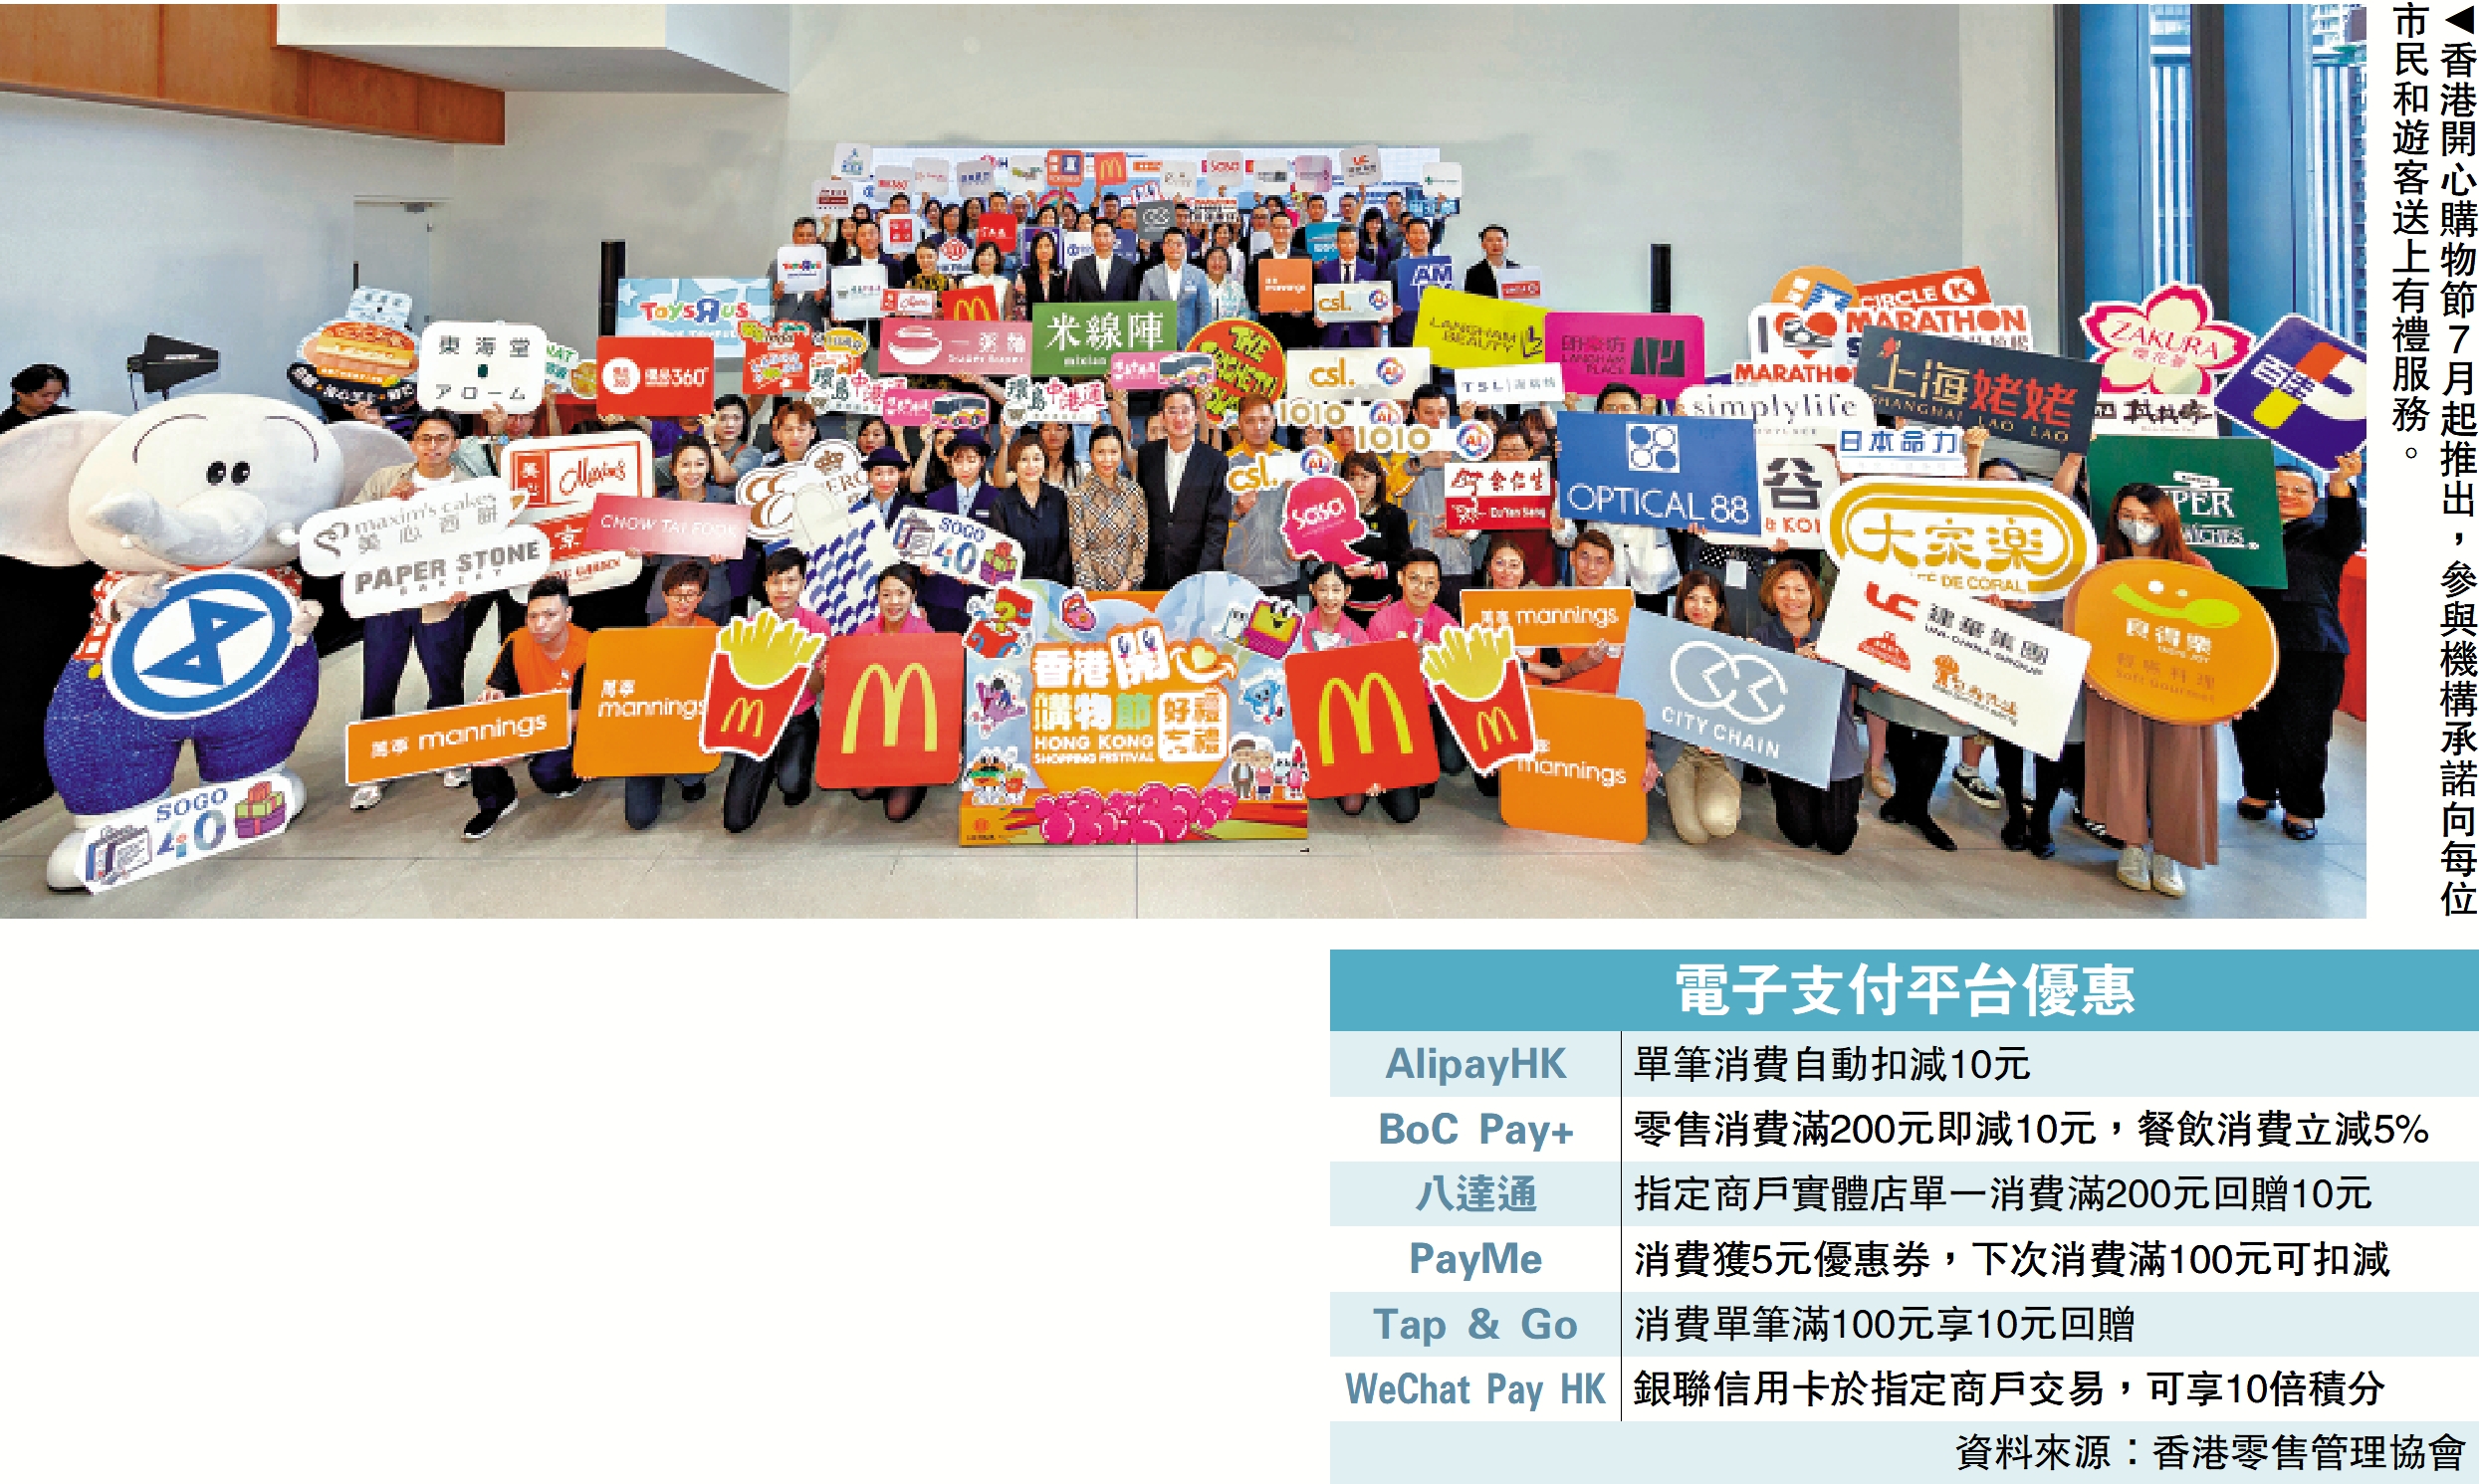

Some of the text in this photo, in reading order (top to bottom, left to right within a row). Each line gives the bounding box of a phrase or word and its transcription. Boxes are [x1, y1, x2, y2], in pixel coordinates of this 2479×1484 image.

[1046, 312, 1164, 350] 米線陣
[1846, 310, 2027, 333] MARATHON
[2110, 319, 2219, 360] ZAKURA
[1309, 357, 1355, 386] csl.
[1693, 392, 1858, 424] simplylife
[1872, 353, 2078, 428] 上海姥姥
[1872, 393, 2070, 443] SHANGHAI LAO LAO
[1840, 430, 1957, 453] 日本命力
[354, 492, 498, 534] maxim's cakes
[1567, 483, 1750, 525] OPTICAL 88
[600, 514, 738, 538] CHOW TAI FOOK
[939, 517, 987, 543] SOGO
[355, 539, 540, 594] PAPER STONE
[1516, 606, 1619, 631] mannings
[597, 697, 704, 721] mannings
[1033, 692, 1153, 731] 購物節
[418, 714, 548, 751] mannings
[1035, 734, 1155, 749] HONG KONG
[1662, 706, 1781, 759] CITY CHAIN
[1033, 752, 1155, 764] SHOPPING FESTIVAL
[155, 787, 229, 824] SOGO
